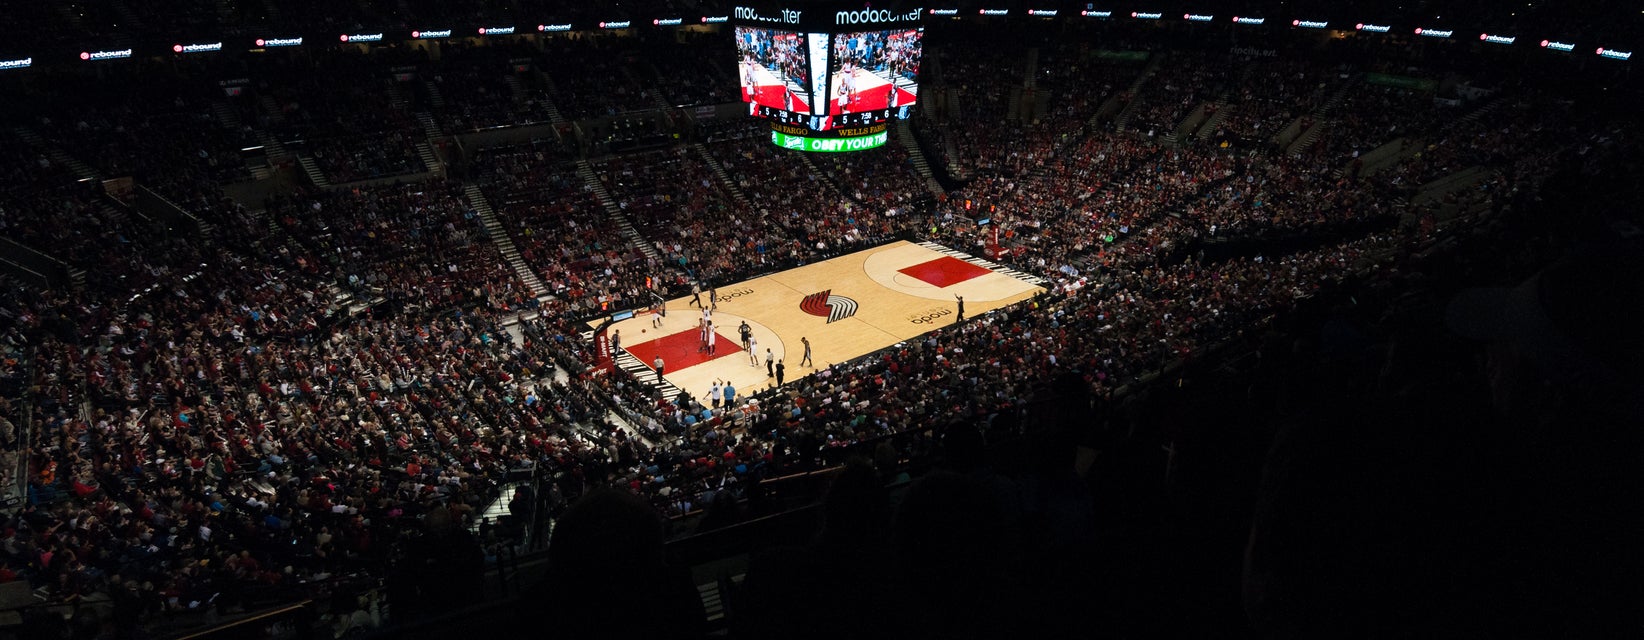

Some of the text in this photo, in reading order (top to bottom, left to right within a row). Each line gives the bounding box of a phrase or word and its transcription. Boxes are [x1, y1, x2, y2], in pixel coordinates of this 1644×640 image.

[605, 20, 630, 29] rebound
[659, 17, 682, 25] rebound
[1238, 16, 1264, 24] rebound
[1299, 20, 1327, 28] rebound
[486, 26, 514, 35] rebound
[544, 23, 571, 32] rebound
[1363, 24, 1390, 33] rebound
[348, 32, 382, 42] rebound
[420, 29, 451, 38] rebound
[1422, 28, 1452, 38] rebound
[265, 37, 302, 46] rebound
[1486, 34, 1515, 44] rebound
[183, 41, 222, 52] rebound
[1548, 41, 1574, 50] rebound
[90, 48, 131, 59] rebound
[1602, 49, 1631, 59] rebound
[842, 115, 848, 124] 5
[884, 109, 890, 118] 6
[784, 126, 808, 135] FARGO
[839, 128, 869, 136] WELLS
[812, 140, 844, 150] OBEY
[846, 137, 873, 150] YOUR
